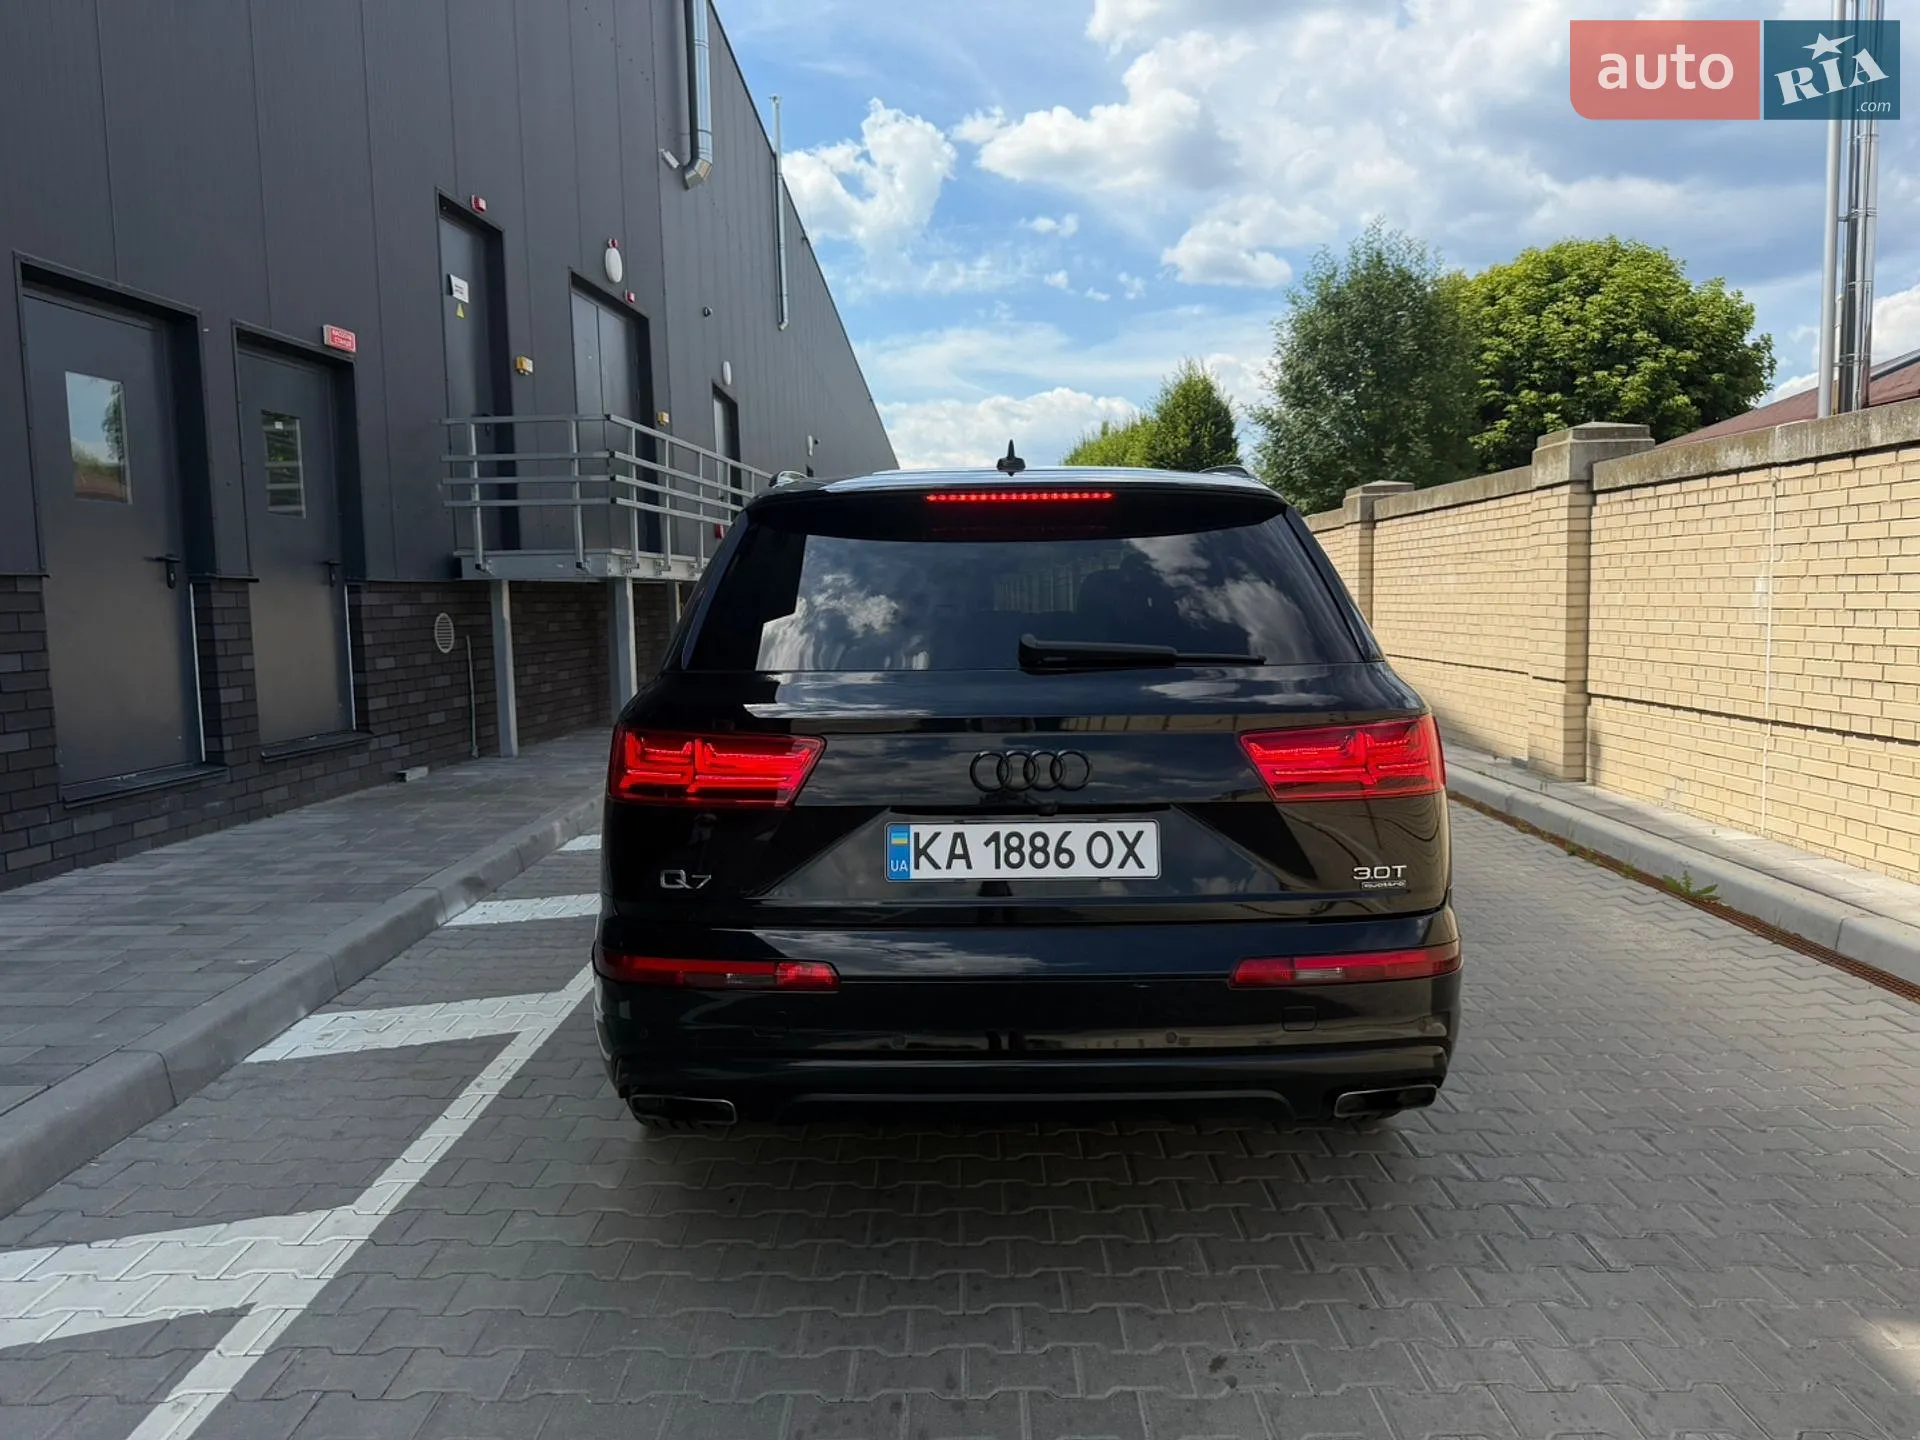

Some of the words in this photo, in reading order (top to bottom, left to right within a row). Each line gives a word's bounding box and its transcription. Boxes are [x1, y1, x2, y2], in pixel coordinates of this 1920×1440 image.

[913, 831, 973, 870] KA
[983, 830, 1076, 870] 1886
[1086, 830, 1146, 870] OX
[890, 860, 908, 872] UA
[1353, 865, 1407, 880] 3.0T
[660, 869, 712, 889] Q7
